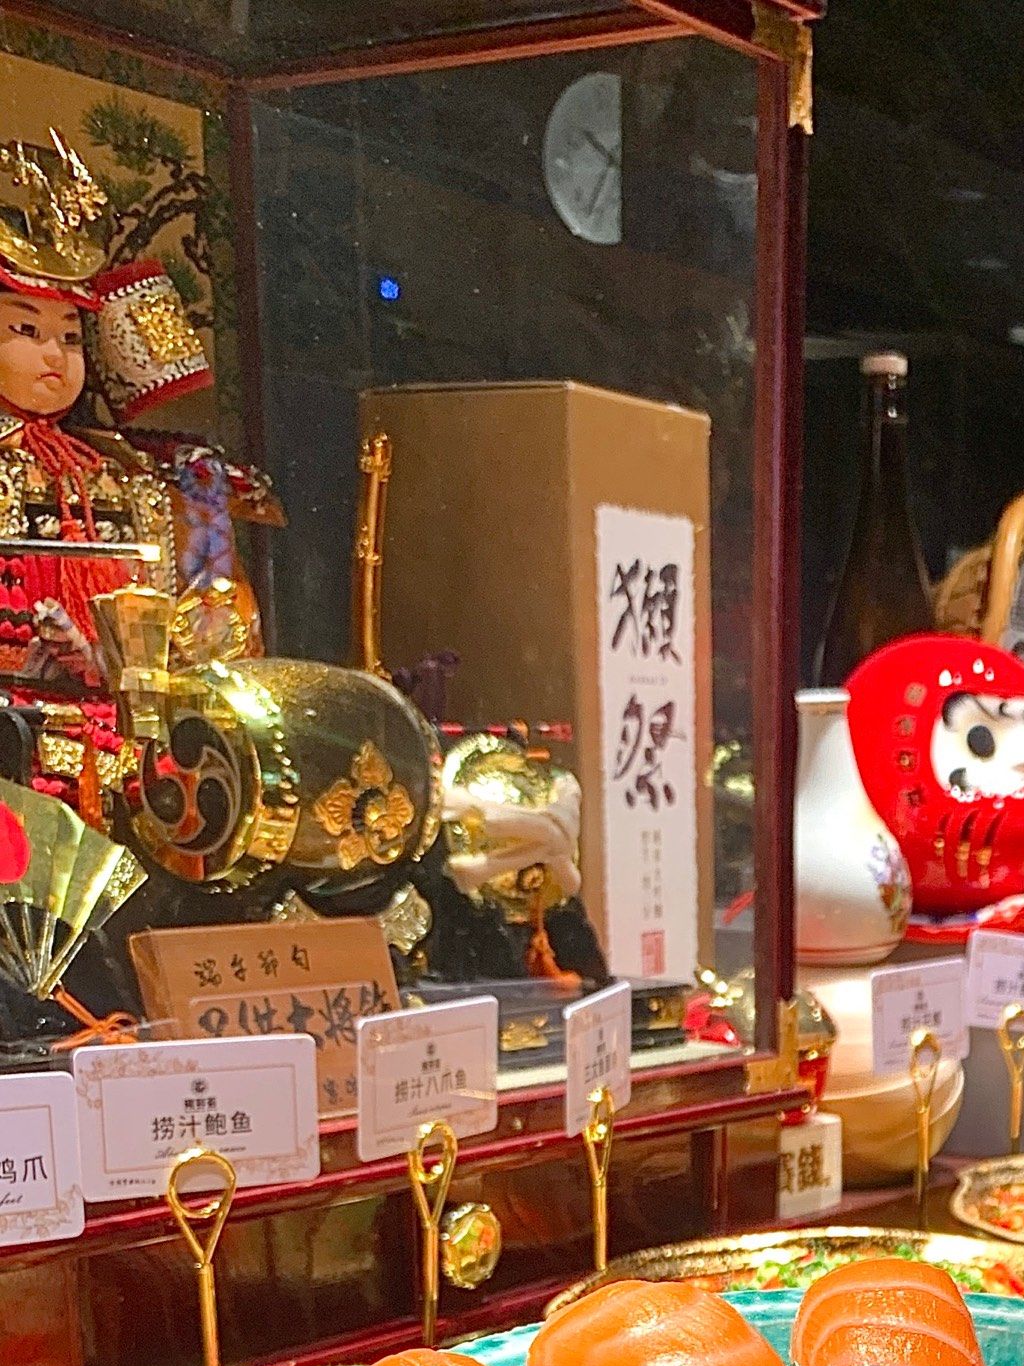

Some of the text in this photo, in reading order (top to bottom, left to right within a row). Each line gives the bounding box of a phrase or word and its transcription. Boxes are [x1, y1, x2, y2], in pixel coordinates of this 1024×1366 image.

[395, 1068, 468, 1104] 捞汁八爪鱼
[152, 1109, 253, 1142] 捞汁鲍鱼
